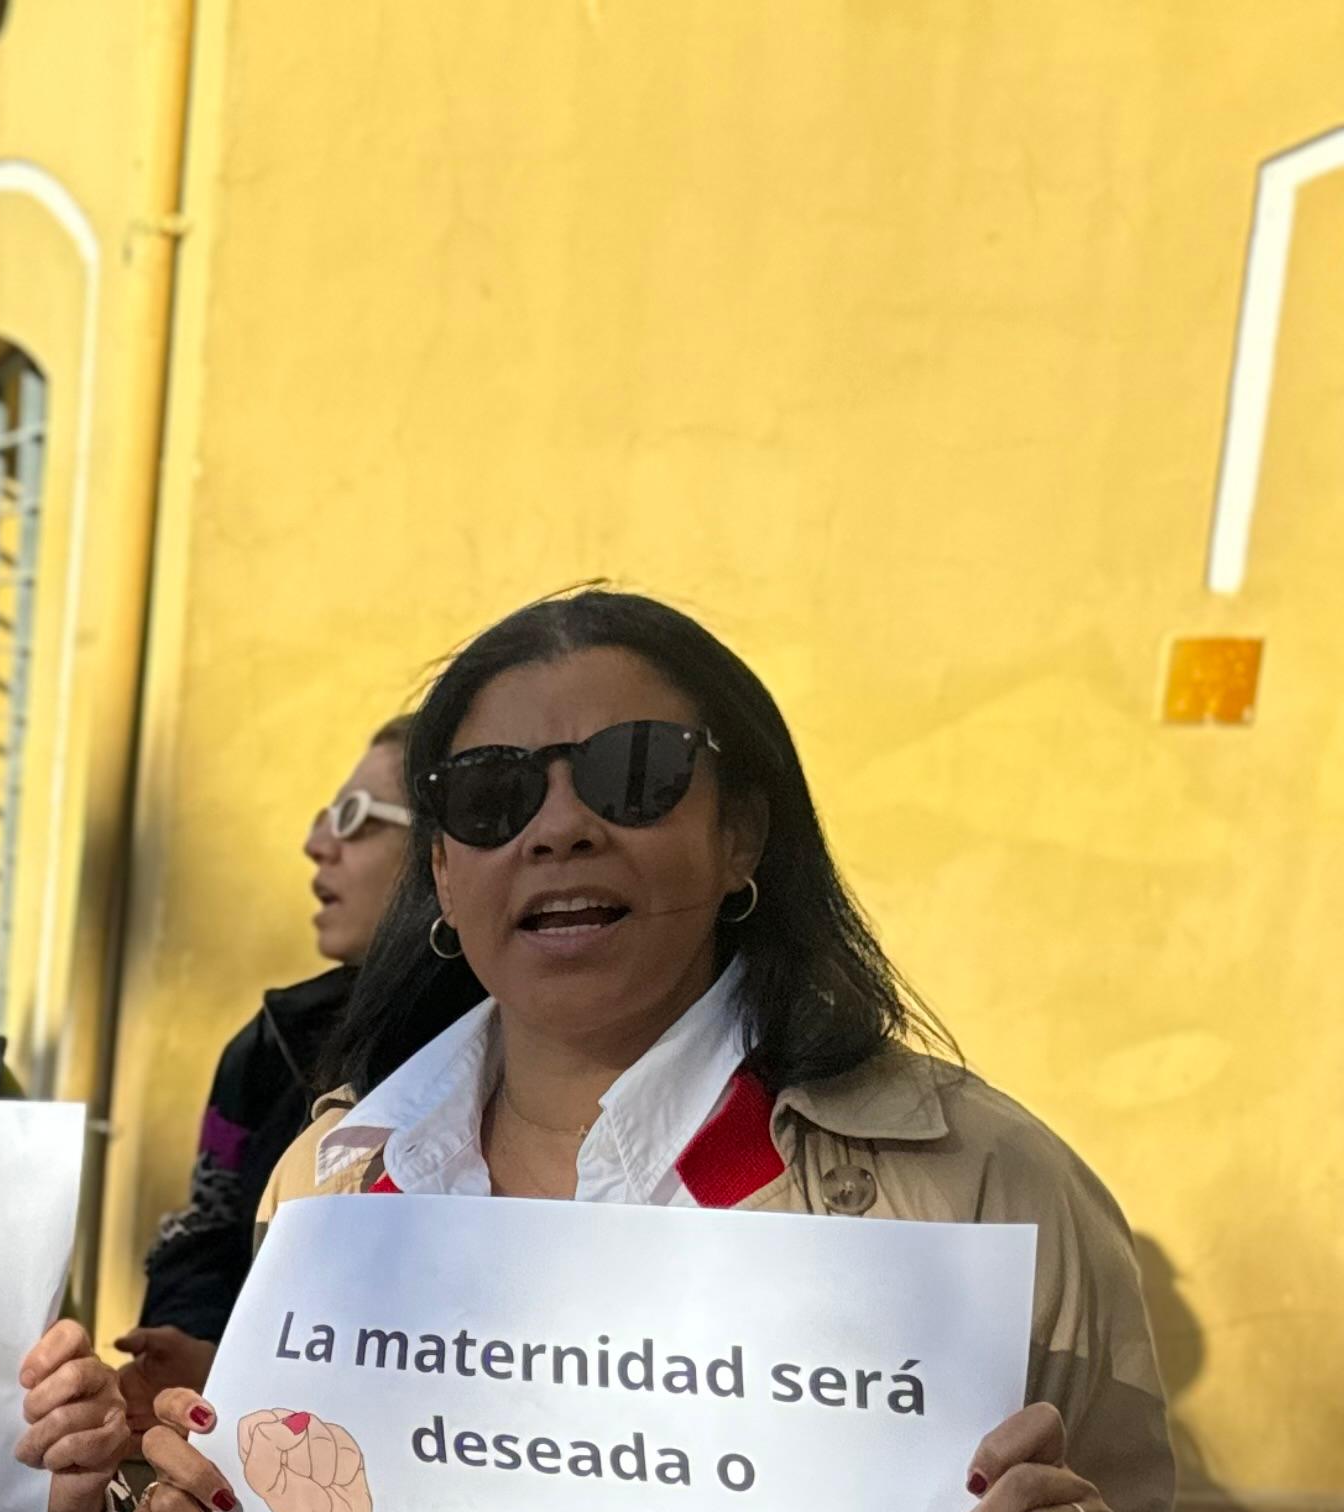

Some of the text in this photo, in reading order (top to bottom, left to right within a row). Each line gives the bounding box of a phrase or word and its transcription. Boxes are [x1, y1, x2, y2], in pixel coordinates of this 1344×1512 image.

[276, 1312, 924, 1416] La maternidad será
[412, 1415, 755, 1491] deseada o
